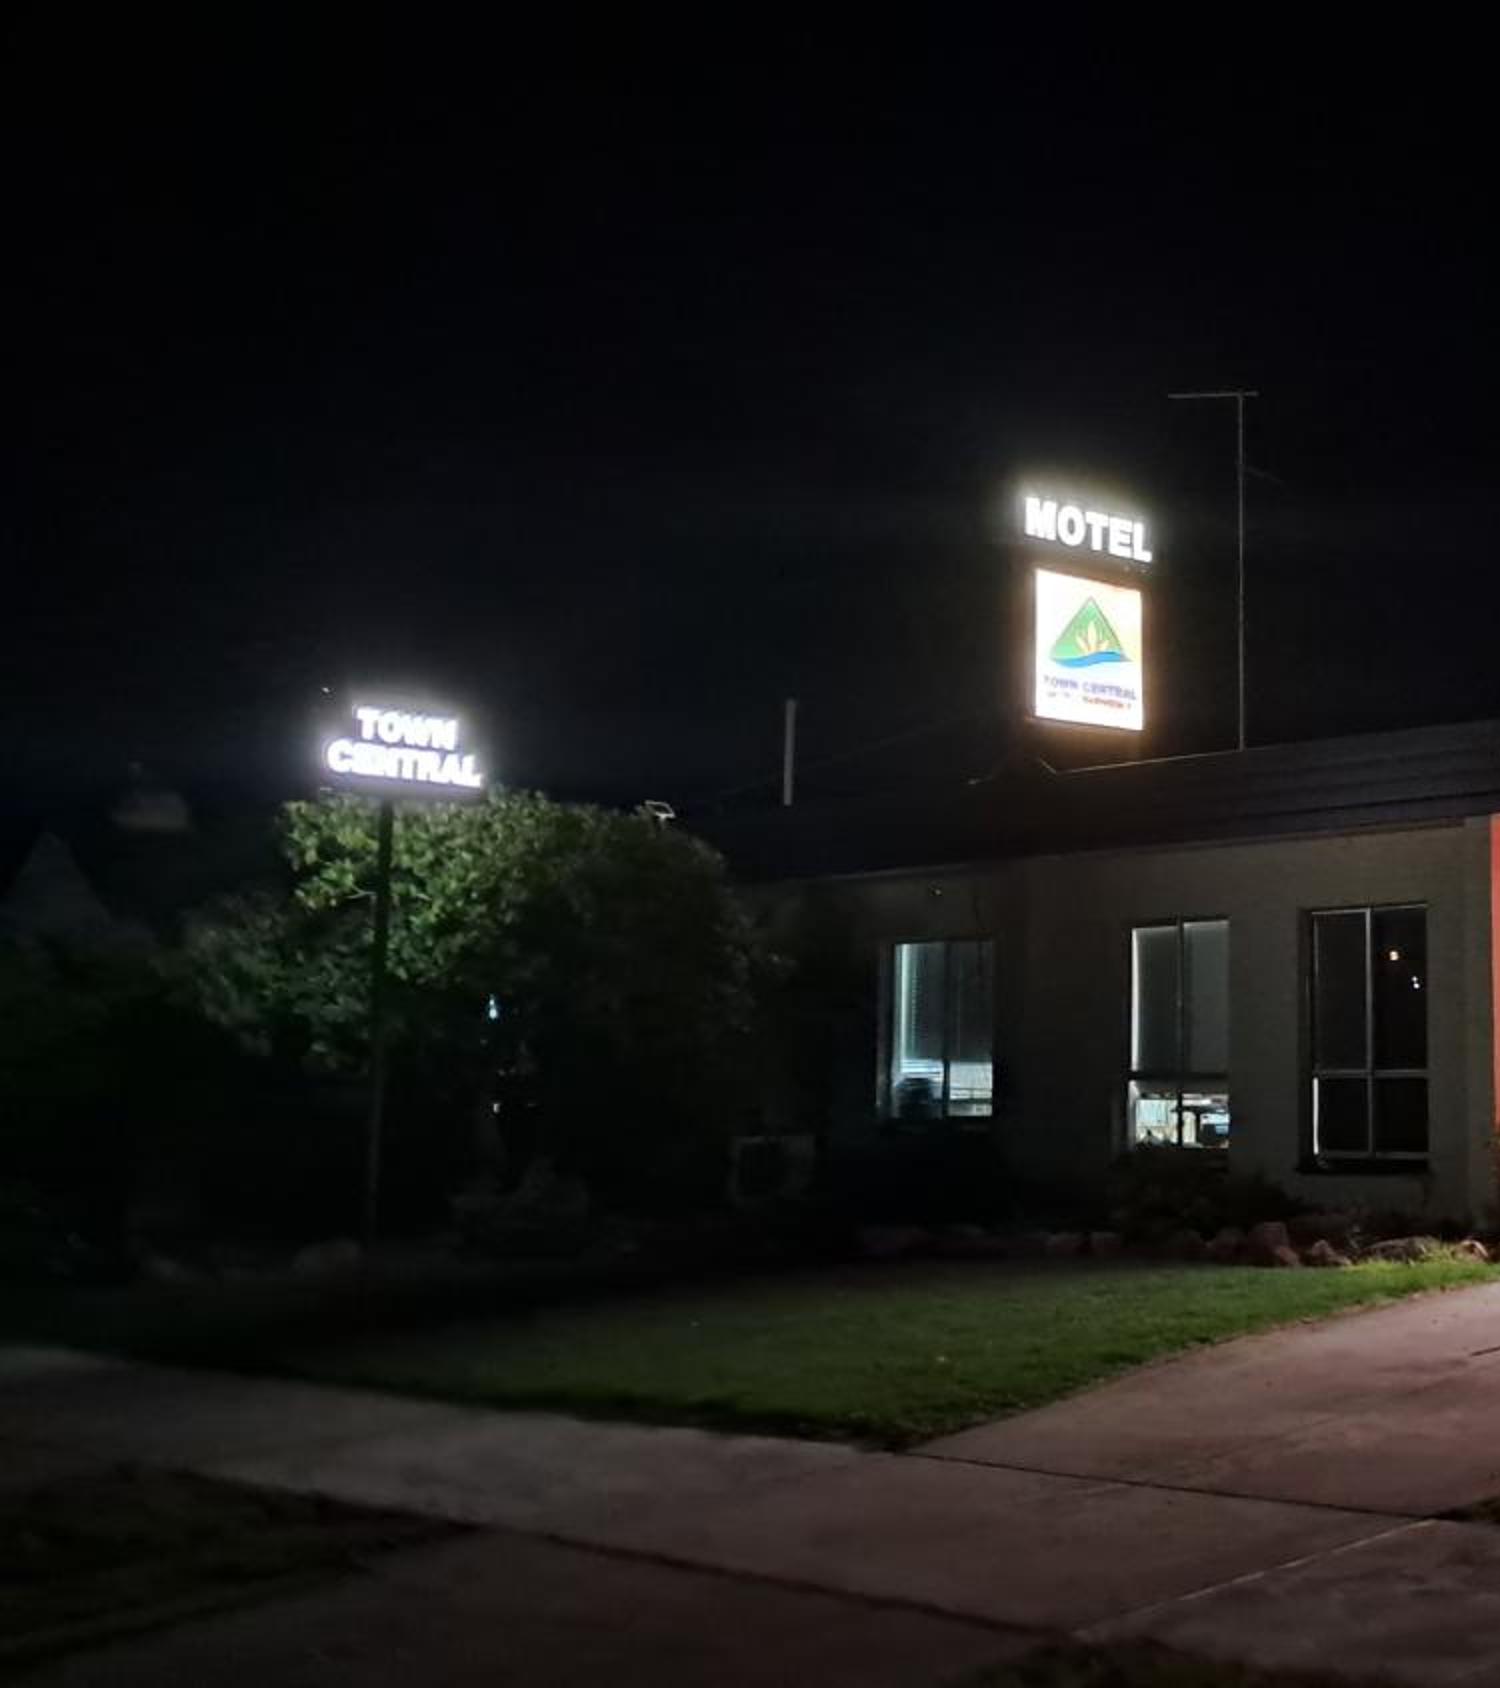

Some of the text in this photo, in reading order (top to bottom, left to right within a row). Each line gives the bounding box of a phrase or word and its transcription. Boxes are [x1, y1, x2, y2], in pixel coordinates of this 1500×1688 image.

[1024, 496, 1153, 563] MOTEL
[1043, 674, 1079, 690] TOWN
[1082, 681, 1137, 702] CENTRAL
[357, 707, 458, 751] TOWN
[327, 738, 483, 788] CENTRAL
